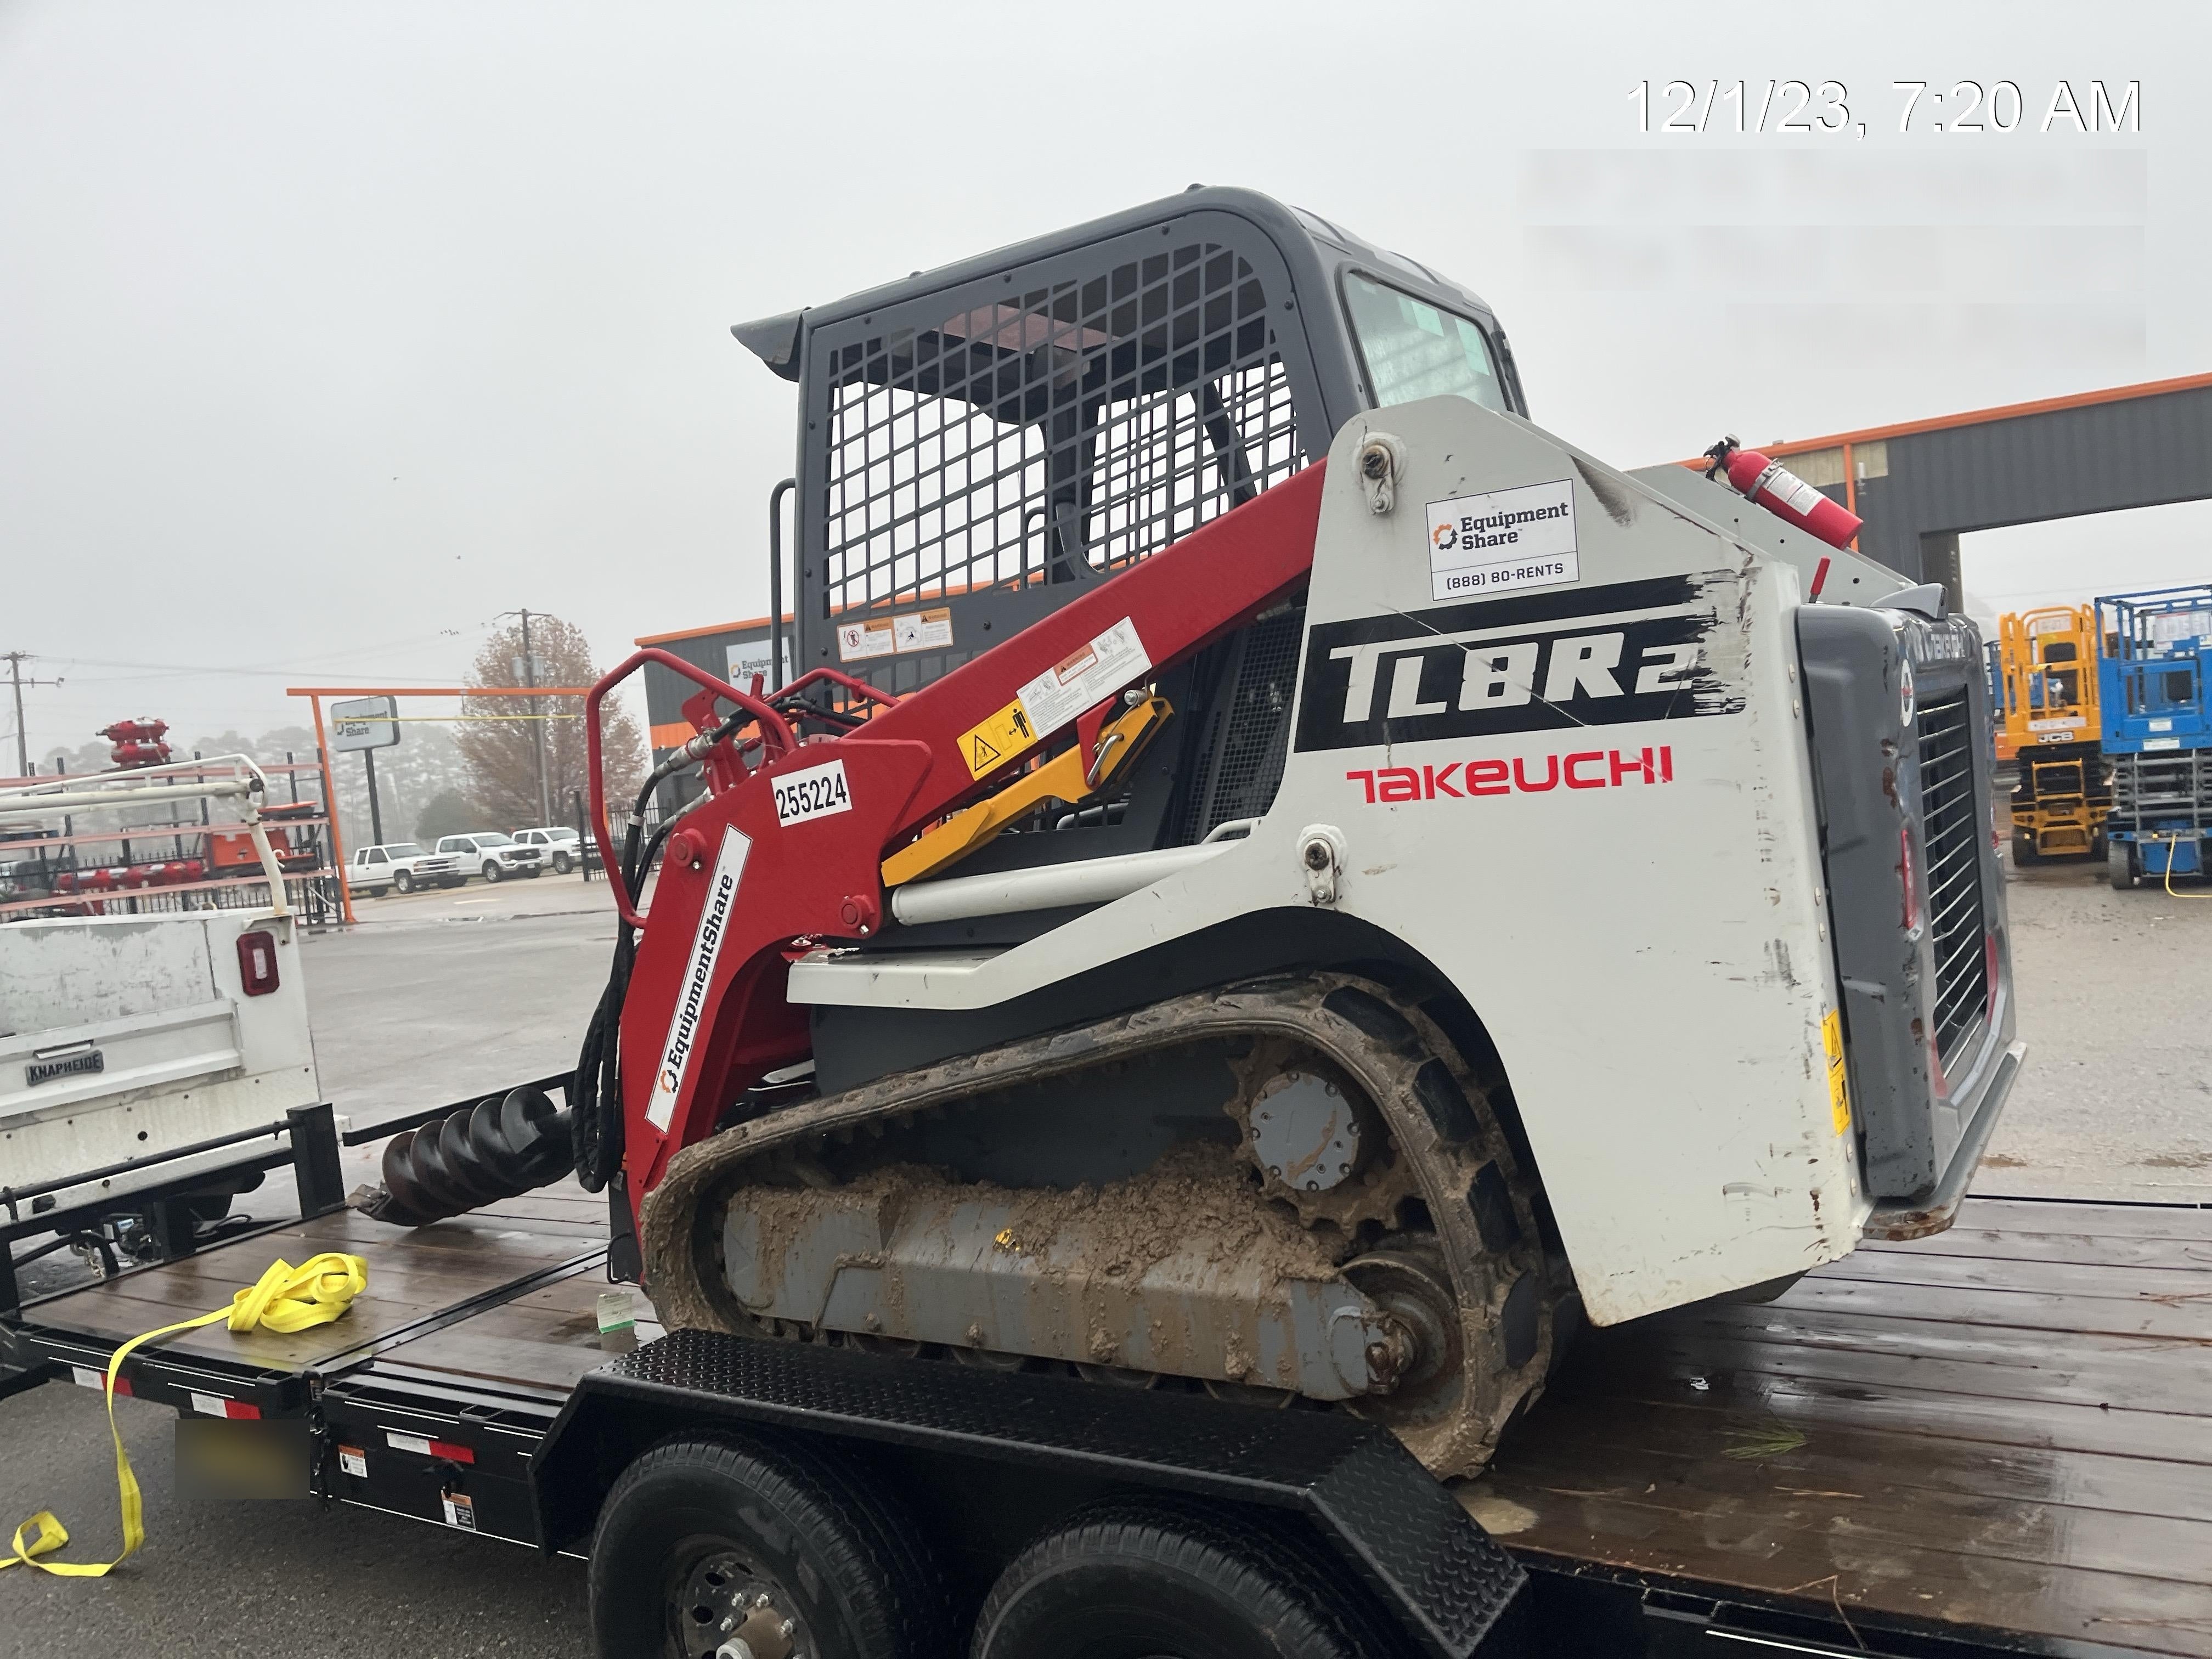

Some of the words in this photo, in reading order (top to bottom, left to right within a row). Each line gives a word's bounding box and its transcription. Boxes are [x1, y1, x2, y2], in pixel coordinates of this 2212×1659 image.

[1460, 502, 1568, 533] Equipment
[1447, 573, 1485, 590] (888)
[1491, 562, 1564, 583] 80-RENTS
[1329, 632, 1700, 723] TL8R2
[346, 727, 370, 737] Share
[2038, 731, 2074, 743] JCB
[775, 772, 847, 819] 255224
[667, 873, 733, 1070] EquipmentShare
[29, 1053, 101, 1082] KNAPHEIDE
